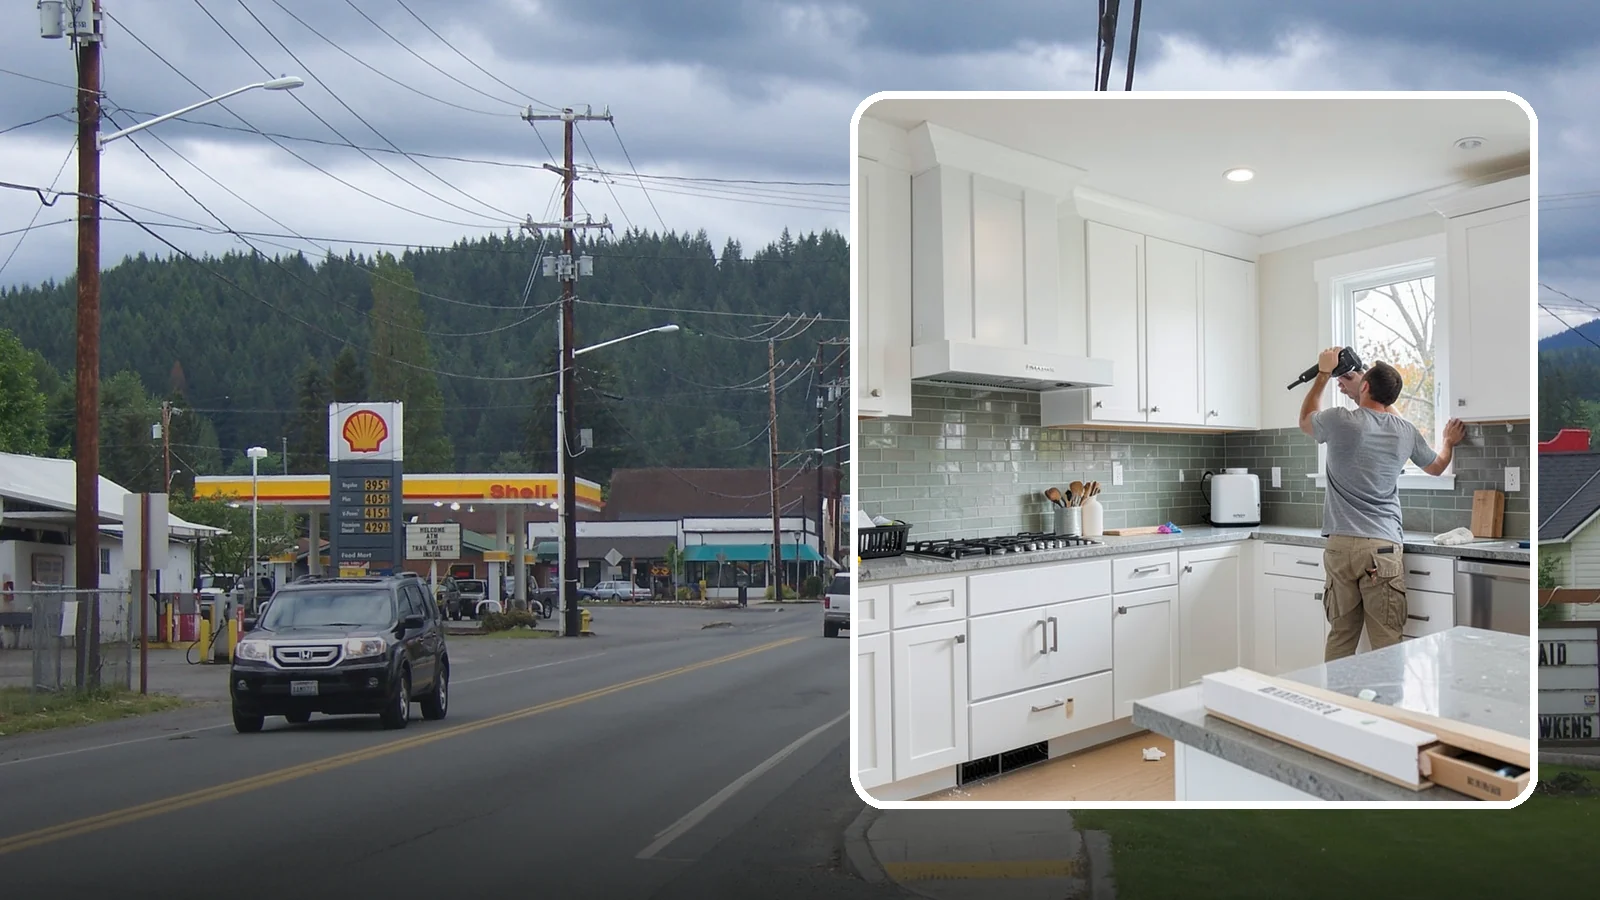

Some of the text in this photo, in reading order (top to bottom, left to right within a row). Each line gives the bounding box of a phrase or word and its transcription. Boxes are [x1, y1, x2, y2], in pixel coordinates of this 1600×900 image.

[366, 480, 384, 490] 395
[490, 484, 547, 499] Shell
[366, 494, 384, 504] 405
[366, 508, 384, 518] 415
[366, 522, 384, 533] 429
[1538, 642, 1567, 665] AID
[1538, 715, 1592, 738] WKENS
